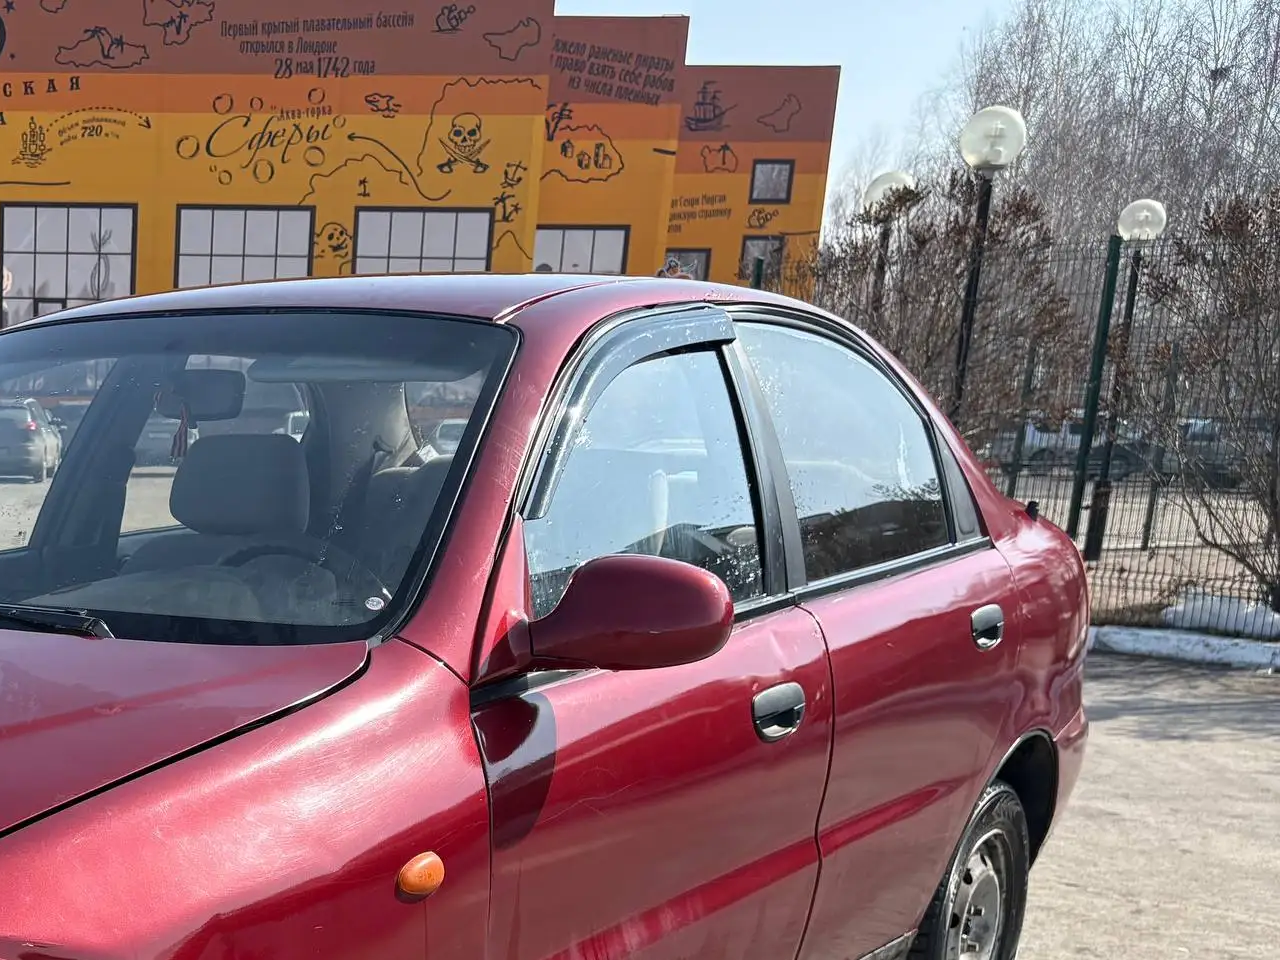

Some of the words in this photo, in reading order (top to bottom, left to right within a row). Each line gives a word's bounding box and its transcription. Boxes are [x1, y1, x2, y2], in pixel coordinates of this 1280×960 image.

[221, 20, 258, 40] Первый
[261, 17, 299, 37] крытый
[302, 13, 373, 33] плавательный
[376, 10, 415, 29] бассейн
[239, 39, 285, 56] открылся
[288, 43, 294, 54] в
[295, 37, 338, 56] Лондоне
[274, 58, 293, 79] 28
[295, 60, 314, 74] мая
[317, 56, 350, 78] 1742
[353, 59, 376, 75] года
[553, 54, 586, 73] право
[588, 61, 616, 80] взять
[618, 66, 642, 86] себе
[642, 73, 675, 92] рабов
[567, 75, 581, 89] из
[583, 79, 614, 98] числа
[81, 125, 103, 138] 720
[205, 113, 333, 169] Сферы
